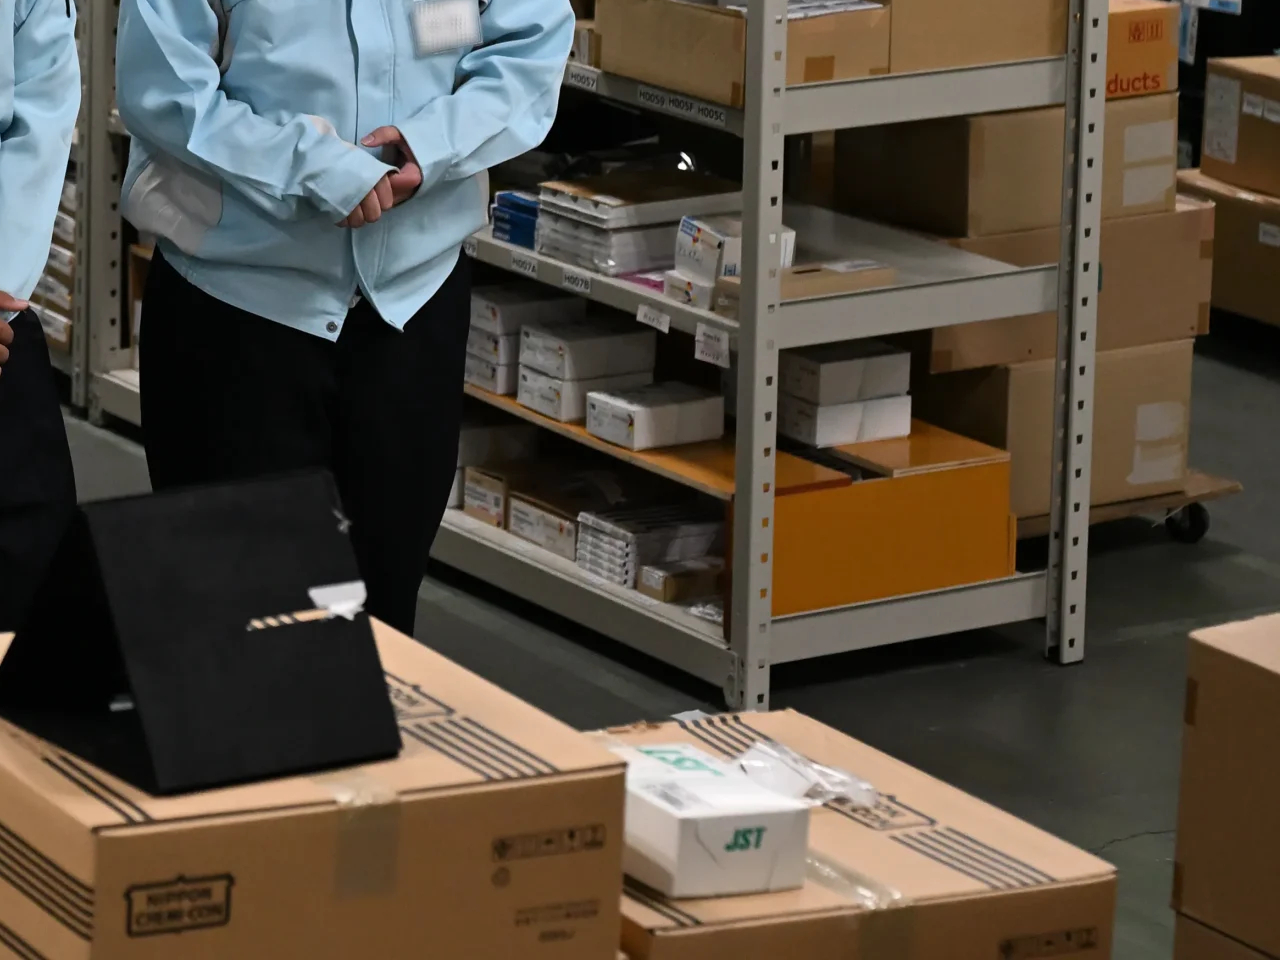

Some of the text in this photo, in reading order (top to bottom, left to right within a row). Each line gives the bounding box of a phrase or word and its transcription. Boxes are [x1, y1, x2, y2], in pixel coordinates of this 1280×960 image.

[570, 71, 596, 88] H0057
[1106, 71, 1161, 94] ducts
[639, 89, 665, 107] H0059
[725, 825, 767, 852] JST
